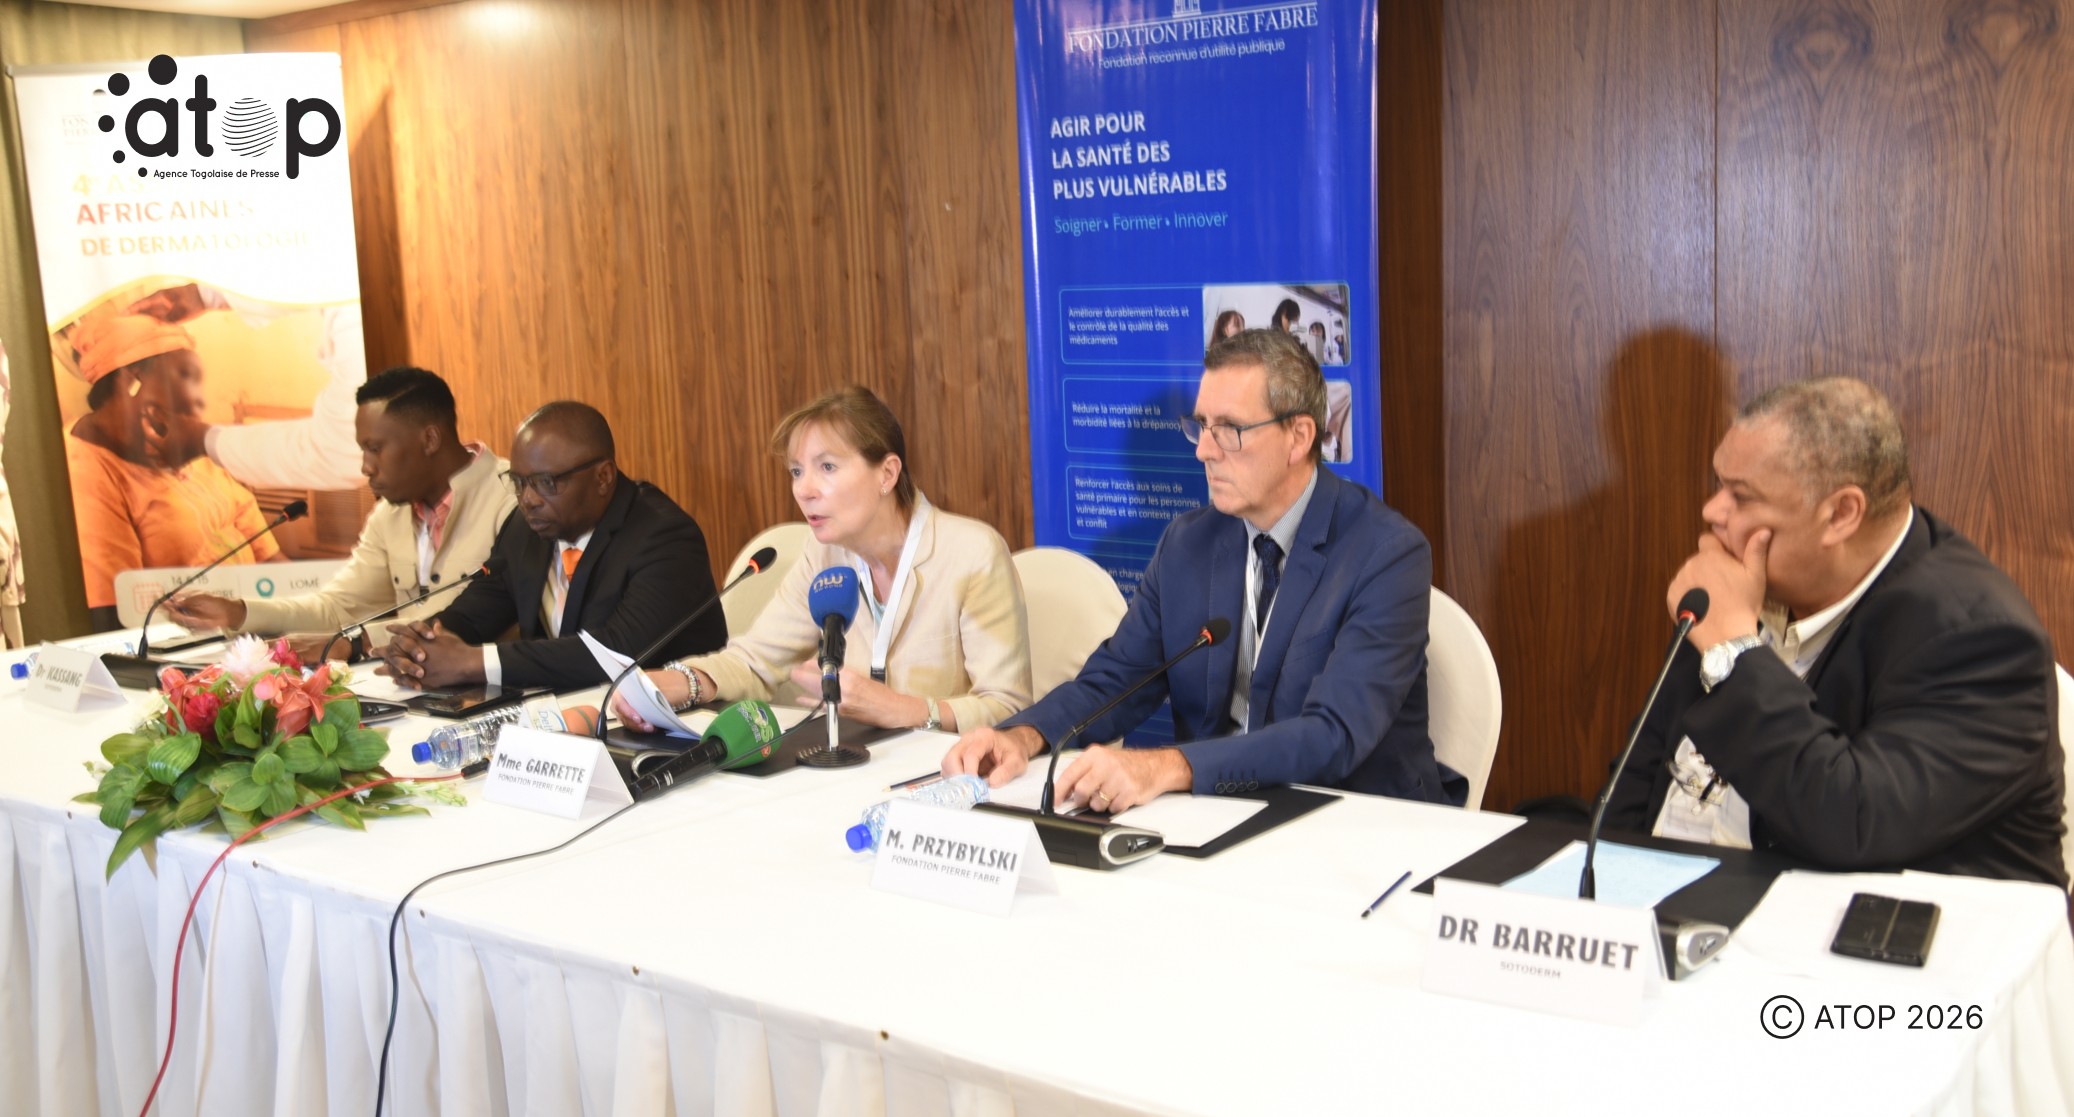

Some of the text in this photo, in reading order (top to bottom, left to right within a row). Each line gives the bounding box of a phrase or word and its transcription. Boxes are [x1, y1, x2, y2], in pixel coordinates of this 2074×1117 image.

[1068, 6, 1318, 53] FONDATION PIERRE FABRE
[1150, 46, 1197, 64] reconnue
[1238, 37, 1285, 57] publique
[1051, 111, 1146, 138] AGIR POUR
[1052, 139, 1170, 169] LA SANTÉ DES
[1053, 168, 1228, 200] PLUS VULNÉRABLES
[1054, 211, 1228, 236] Soigner Former Innover
[81, 237, 112, 256] DE
[1068, 304, 1189, 317] Améliorer durablement l'accès et
[1069, 320, 1169, 333] le contrôle de la qualité des
[1069, 334, 1118, 345] médicaments
[1072, 401, 1160, 416] Réduire la mortalité et la
[1072, 416, 1107, 427] morbidité
[1109, 416, 1126, 428] liées
[1133, 417, 1140, 429] la
[1075, 476, 1182, 494] Renforcer l'accès aux soins de
[1075, 491, 1201, 508] santé primaire pour les personnes
[1075, 504, 1117, 516] vulnérables
[1119, 506, 1126, 517] et
[1128, 507, 1137, 517] en
[1139, 507, 1170, 519] contexte
[1076, 517, 1107, 529] et conflit
[47, 665, 83, 688] KASSANG
[497, 752, 586, 783] Mme GARRETTE
[498, 773, 574, 795] FONDATION PIERRE FABRE
[886, 829, 1018, 872] M. PRZYBYLSKI
[892, 855, 1000, 885] FONDATION PIERRE FABRE
[1438, 914, 1639, 971] DR BARRUET
[1499, 961, 1562, 979] SOTODERM
